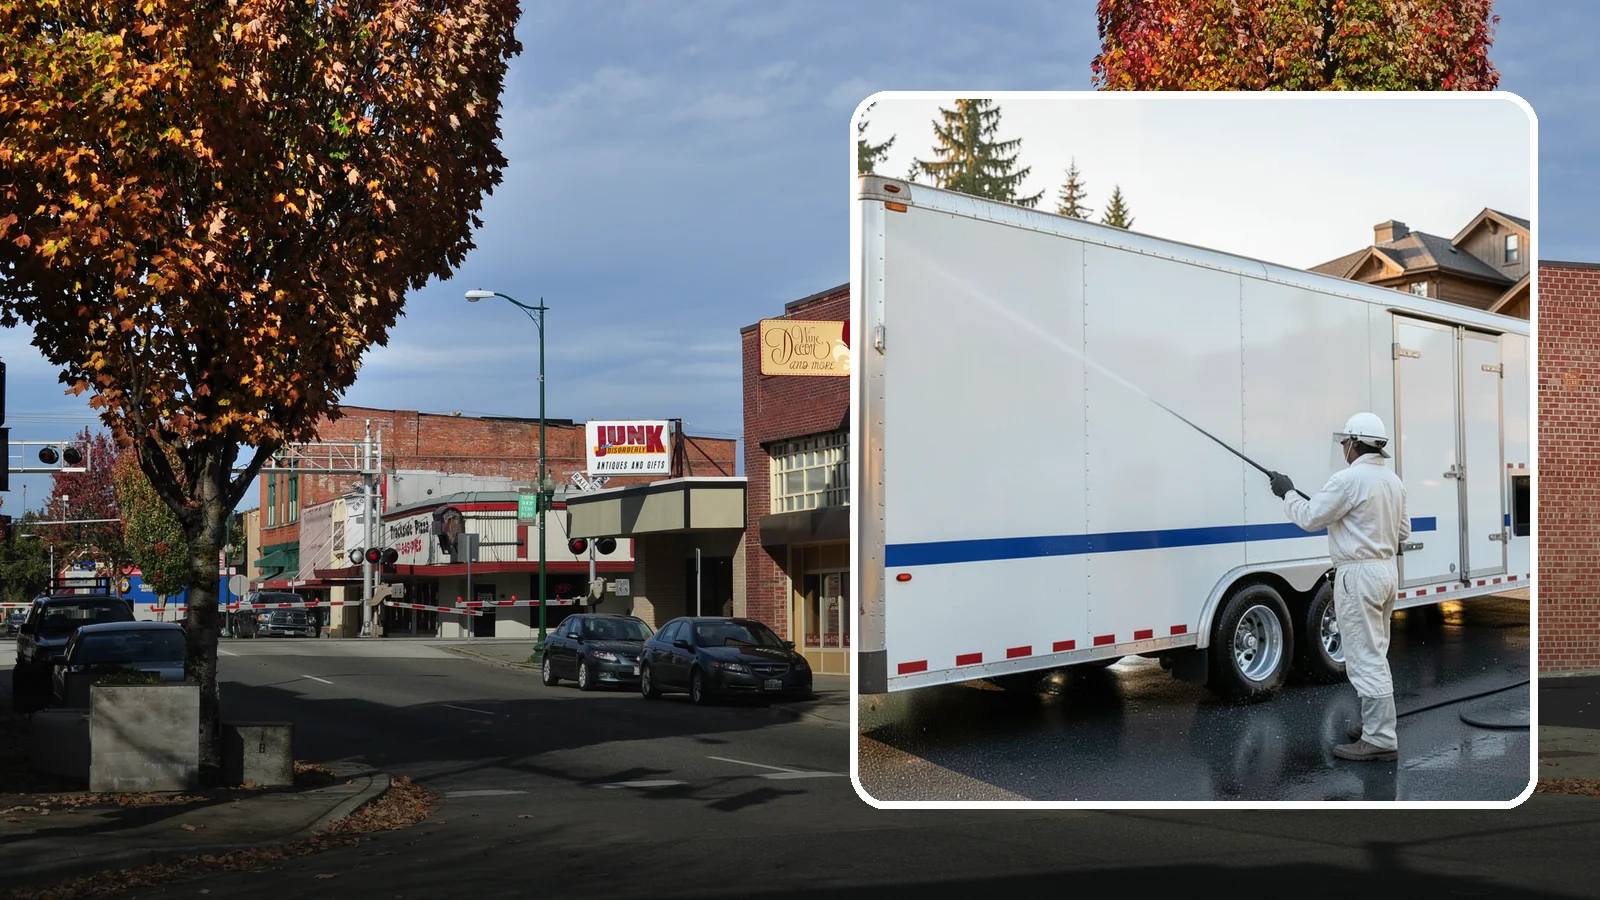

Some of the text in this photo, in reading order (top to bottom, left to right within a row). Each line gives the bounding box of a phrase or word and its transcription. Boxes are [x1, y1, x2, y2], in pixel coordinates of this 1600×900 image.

[595, 425, 665, 457] JUNK
[607, 446, 646, 454] DISORDERLY
[597, 460, 665, 470] ANTIQUES AND GIFTS
[573, 473, 588, 490] RAIL
[352, 498, 365, 511] CRO
[390, 519, 429, 540] Trackside Pizza
